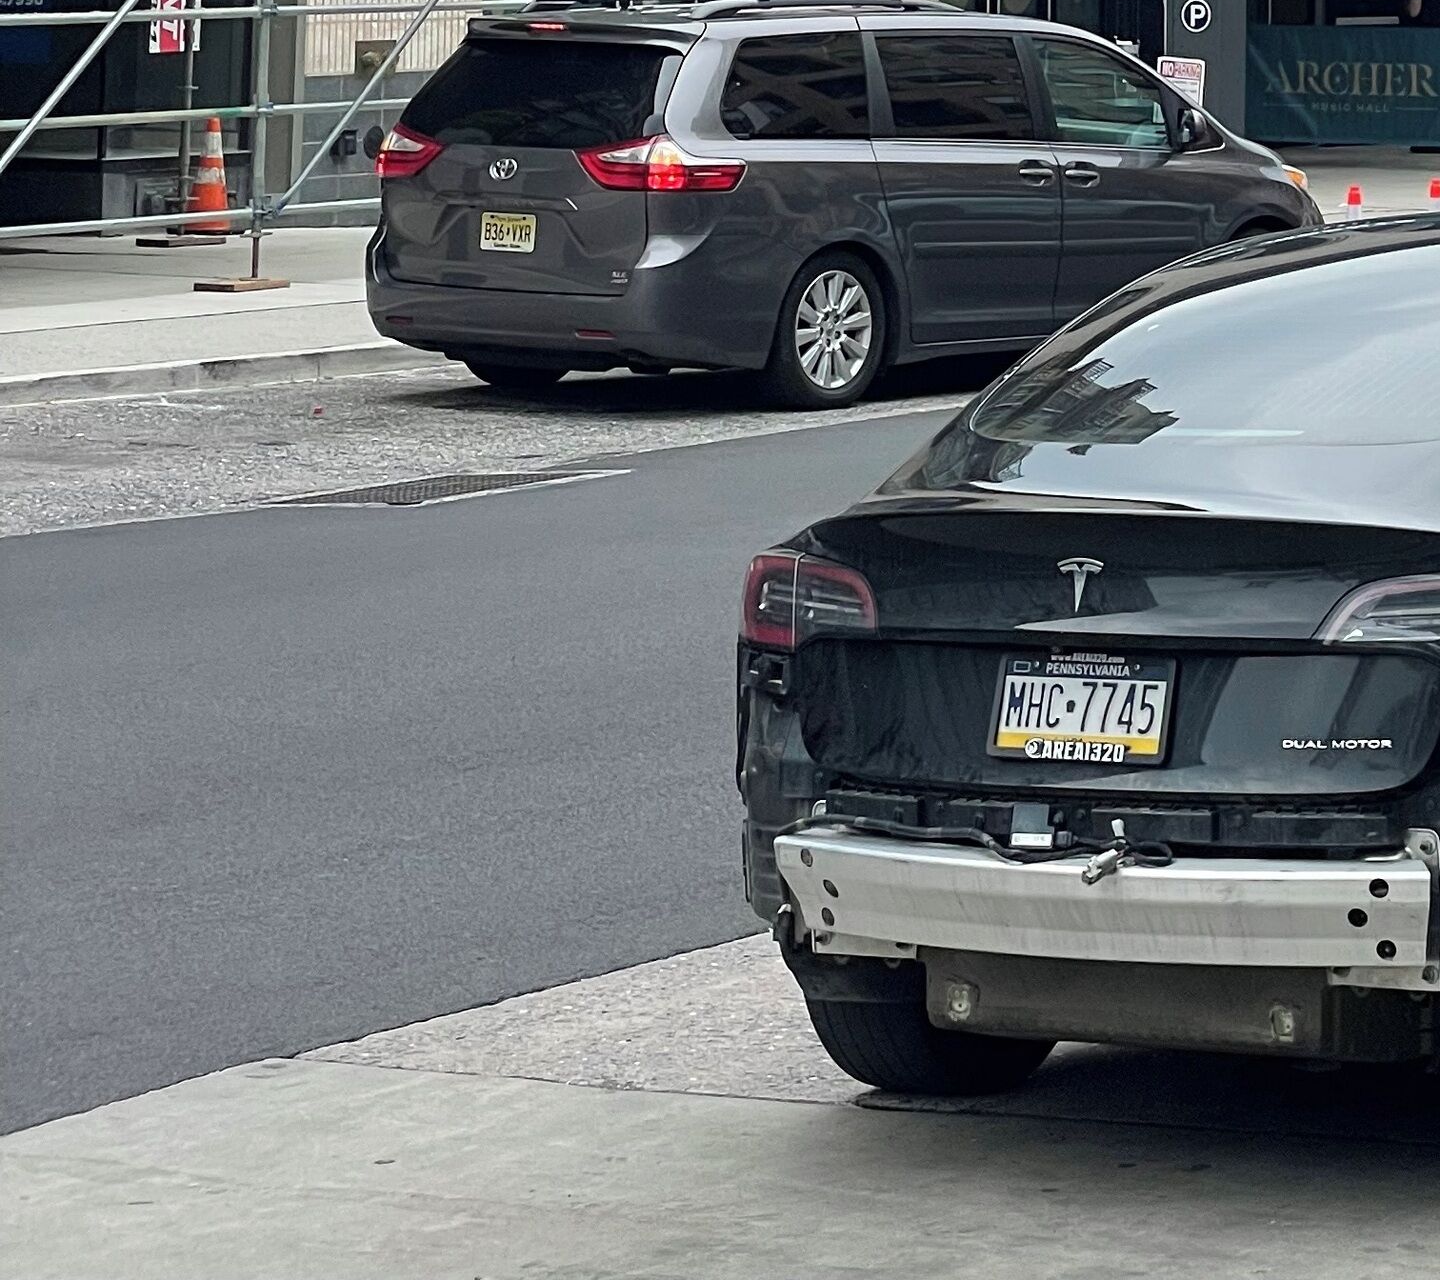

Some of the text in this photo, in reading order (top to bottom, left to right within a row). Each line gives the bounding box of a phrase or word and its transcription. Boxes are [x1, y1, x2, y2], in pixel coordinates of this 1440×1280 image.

[1190, 4, 1206, 28] P
[1162, 61, 1174, 77] NO
[1265, 59, 1439, 98] ARCHER
[1311, 102, 1389, 113] MUSIC HALL
[1045, 662, 1131, 677] PENNSYLVANIA
[1282, 739, 1393, 750] DUAL MOTOR
